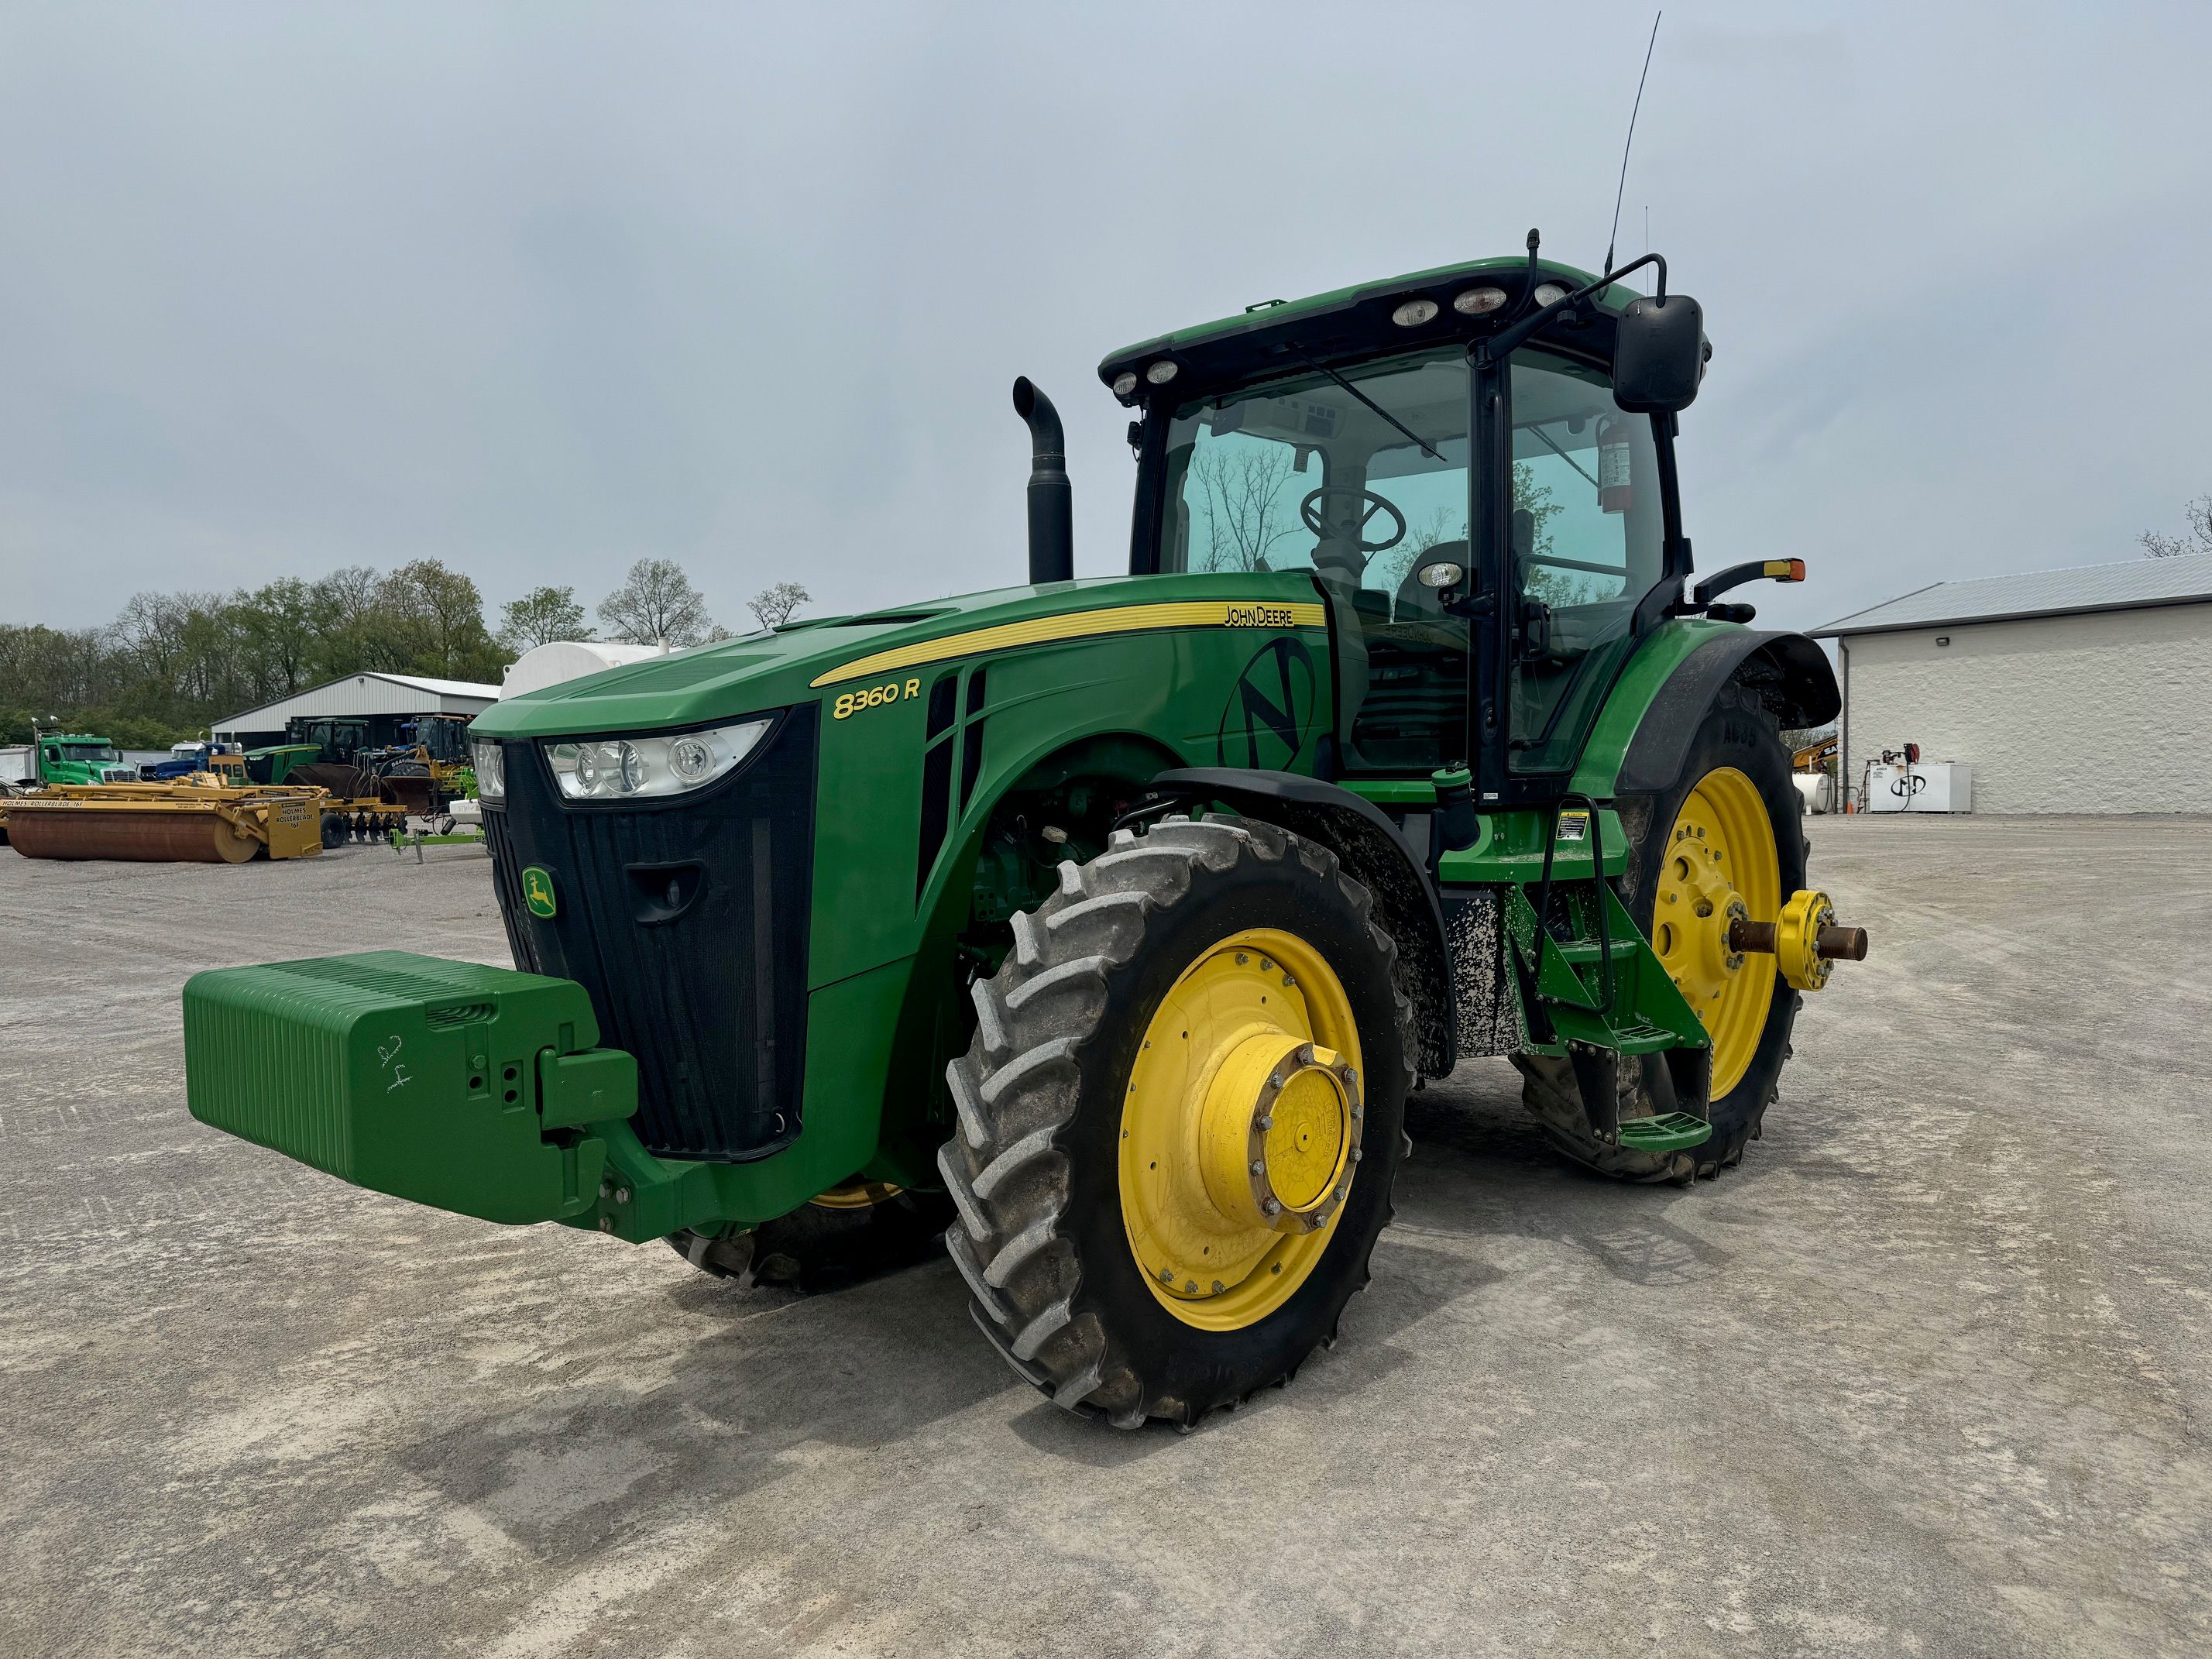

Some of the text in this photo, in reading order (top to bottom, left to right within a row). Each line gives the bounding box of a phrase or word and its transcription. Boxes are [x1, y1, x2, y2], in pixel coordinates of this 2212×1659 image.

[1224, 606, 1293, 625] JOHN DEERE
[833, 678, 921, 720] 8360 R
[1824, 744, 1838, 755] SA
[276, 814, 314, 823] ROLLERBLADE
